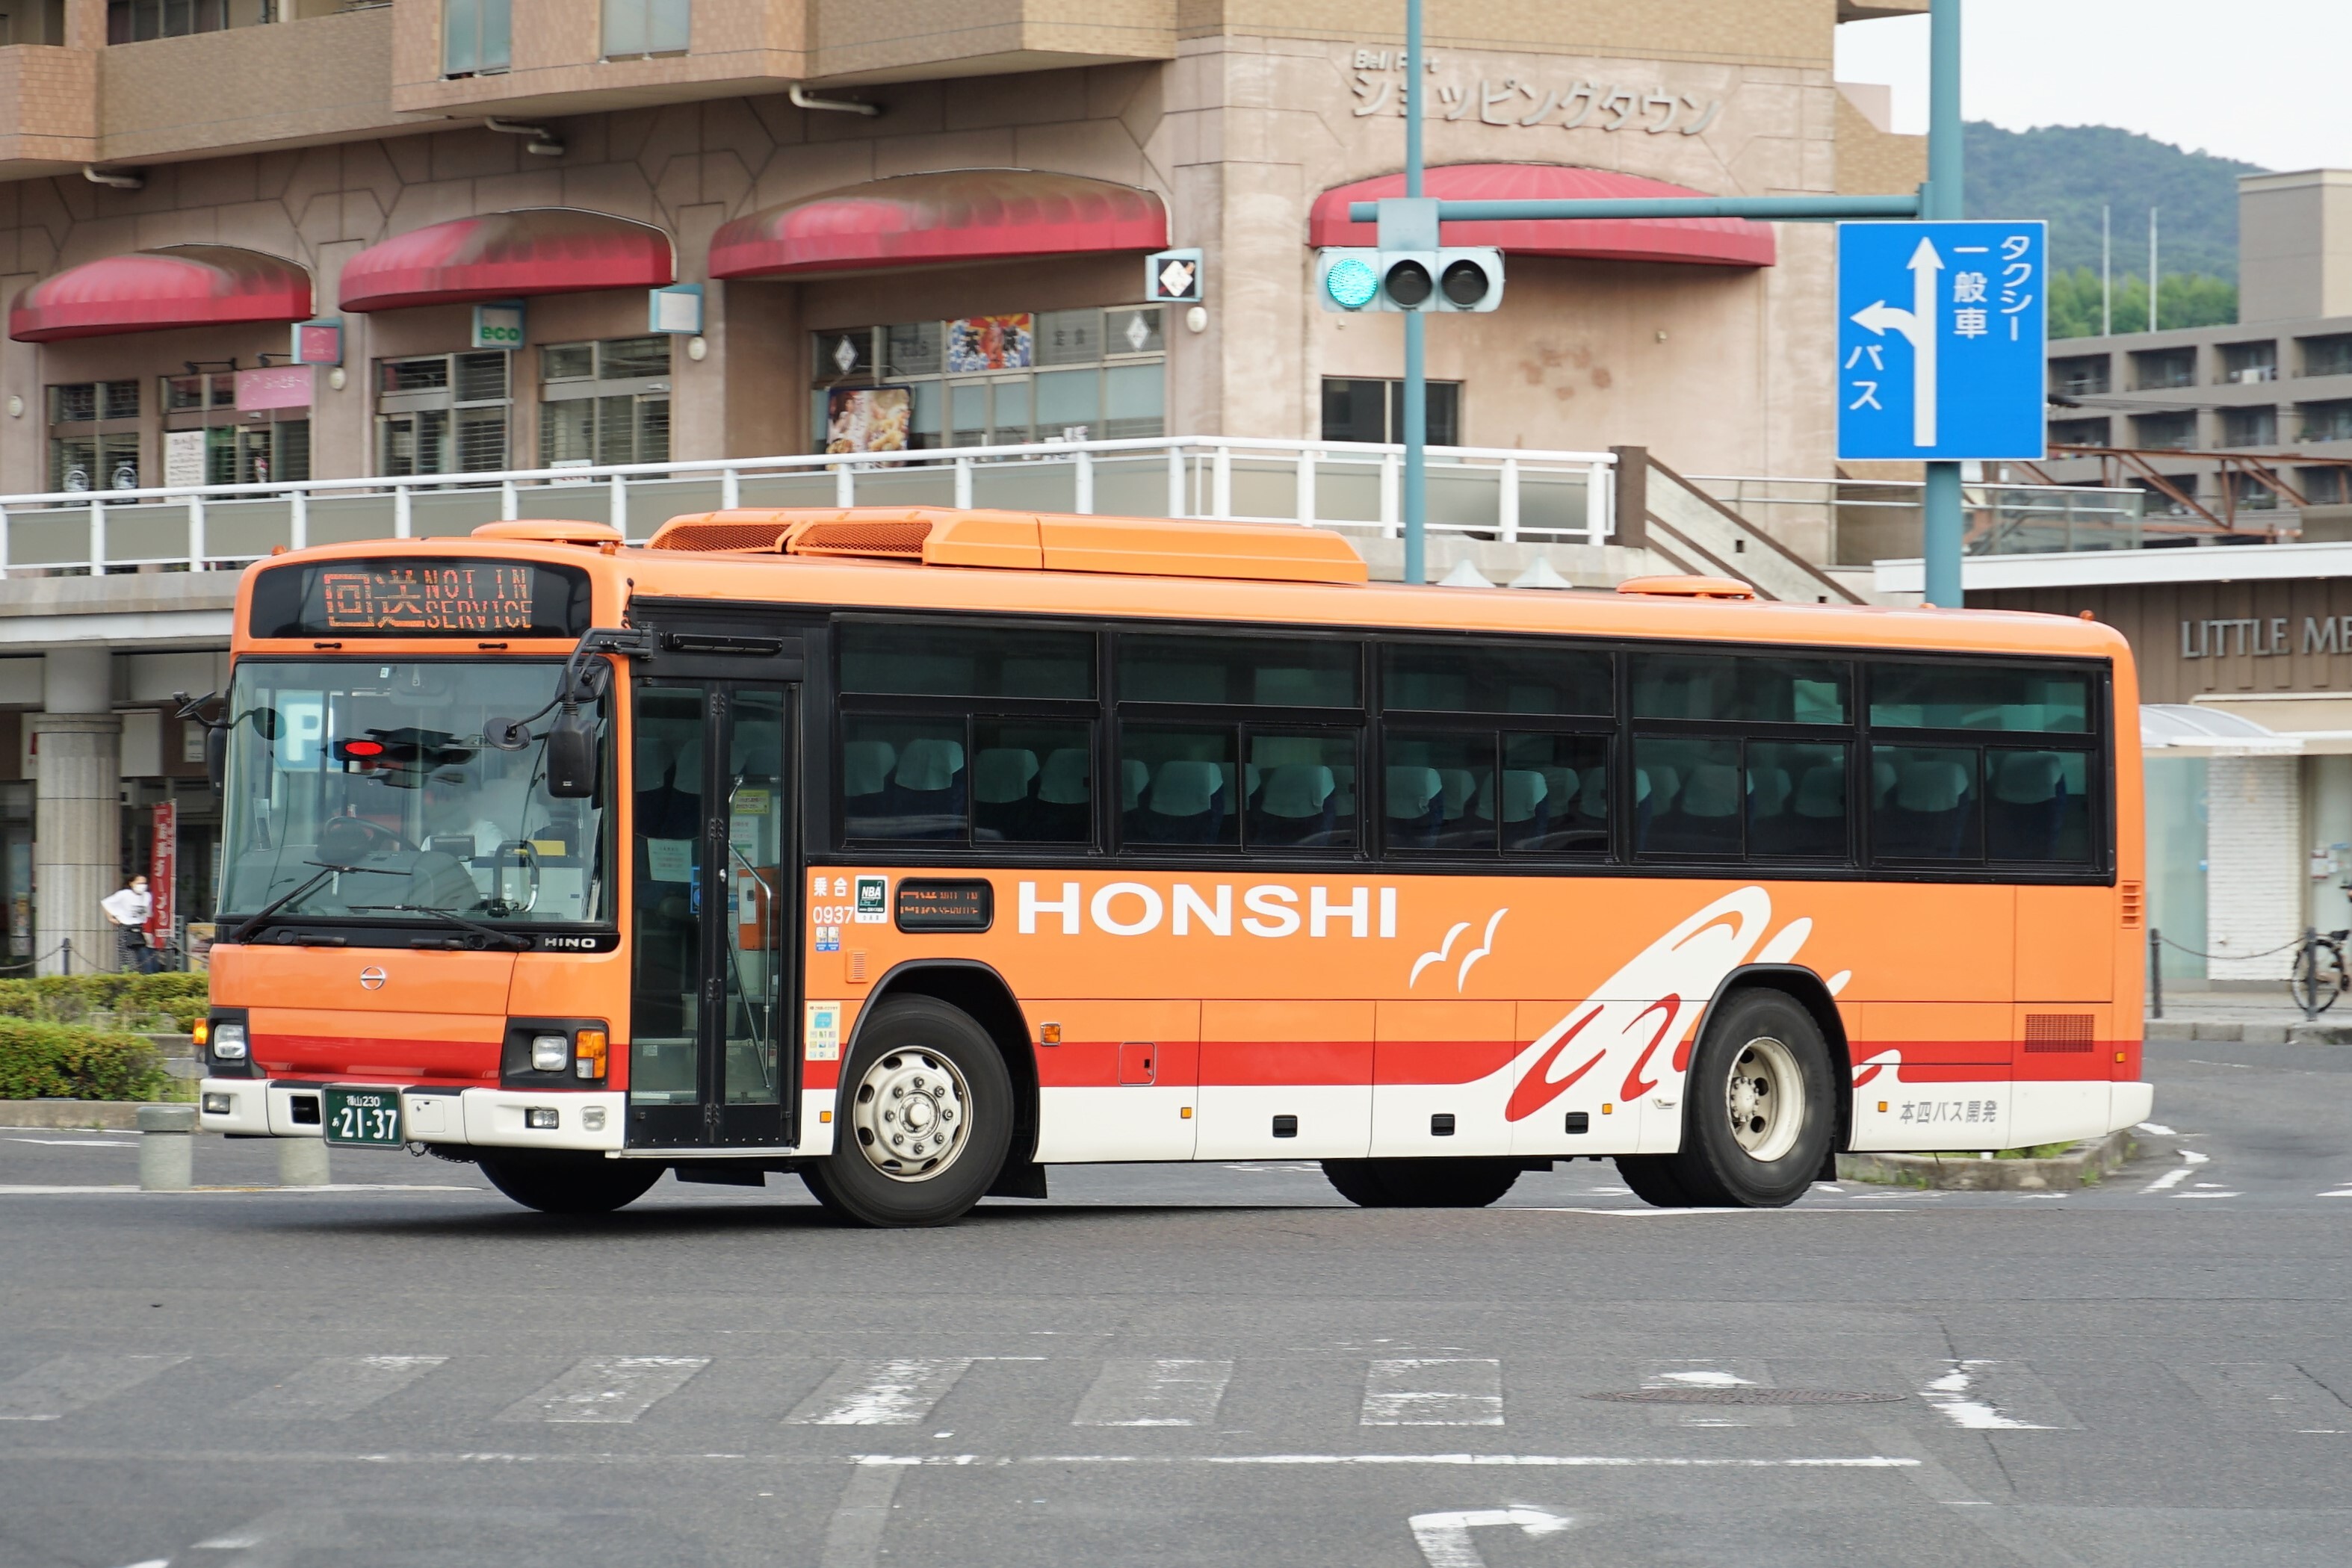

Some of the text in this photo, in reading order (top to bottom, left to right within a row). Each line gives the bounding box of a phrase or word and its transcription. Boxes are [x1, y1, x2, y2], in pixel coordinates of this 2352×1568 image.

[1953, 247, 1990, 339] 一般車
[2000, 236, 2032, 341] タクシー
[481, 326, 521, 341] eco
[1845, 344, 1884, 410] バス
[324, 568, 426, 629] 回送
[424, 568, 527, 600] NOT IN
[425, 600, 533, 630] SERVICE
[2181, 616, 2291, 658] LITTLE
[814, 877, 847, 897] 乗合
[861, 886, 882, 898] NBA
[813, 905, 854, 924] 0937
[1018, 881, 1396, 938] HONSHI
[544, 938, 595, 948] HINO
[1899, 1100, 1998, 1124] 本四バス開発
